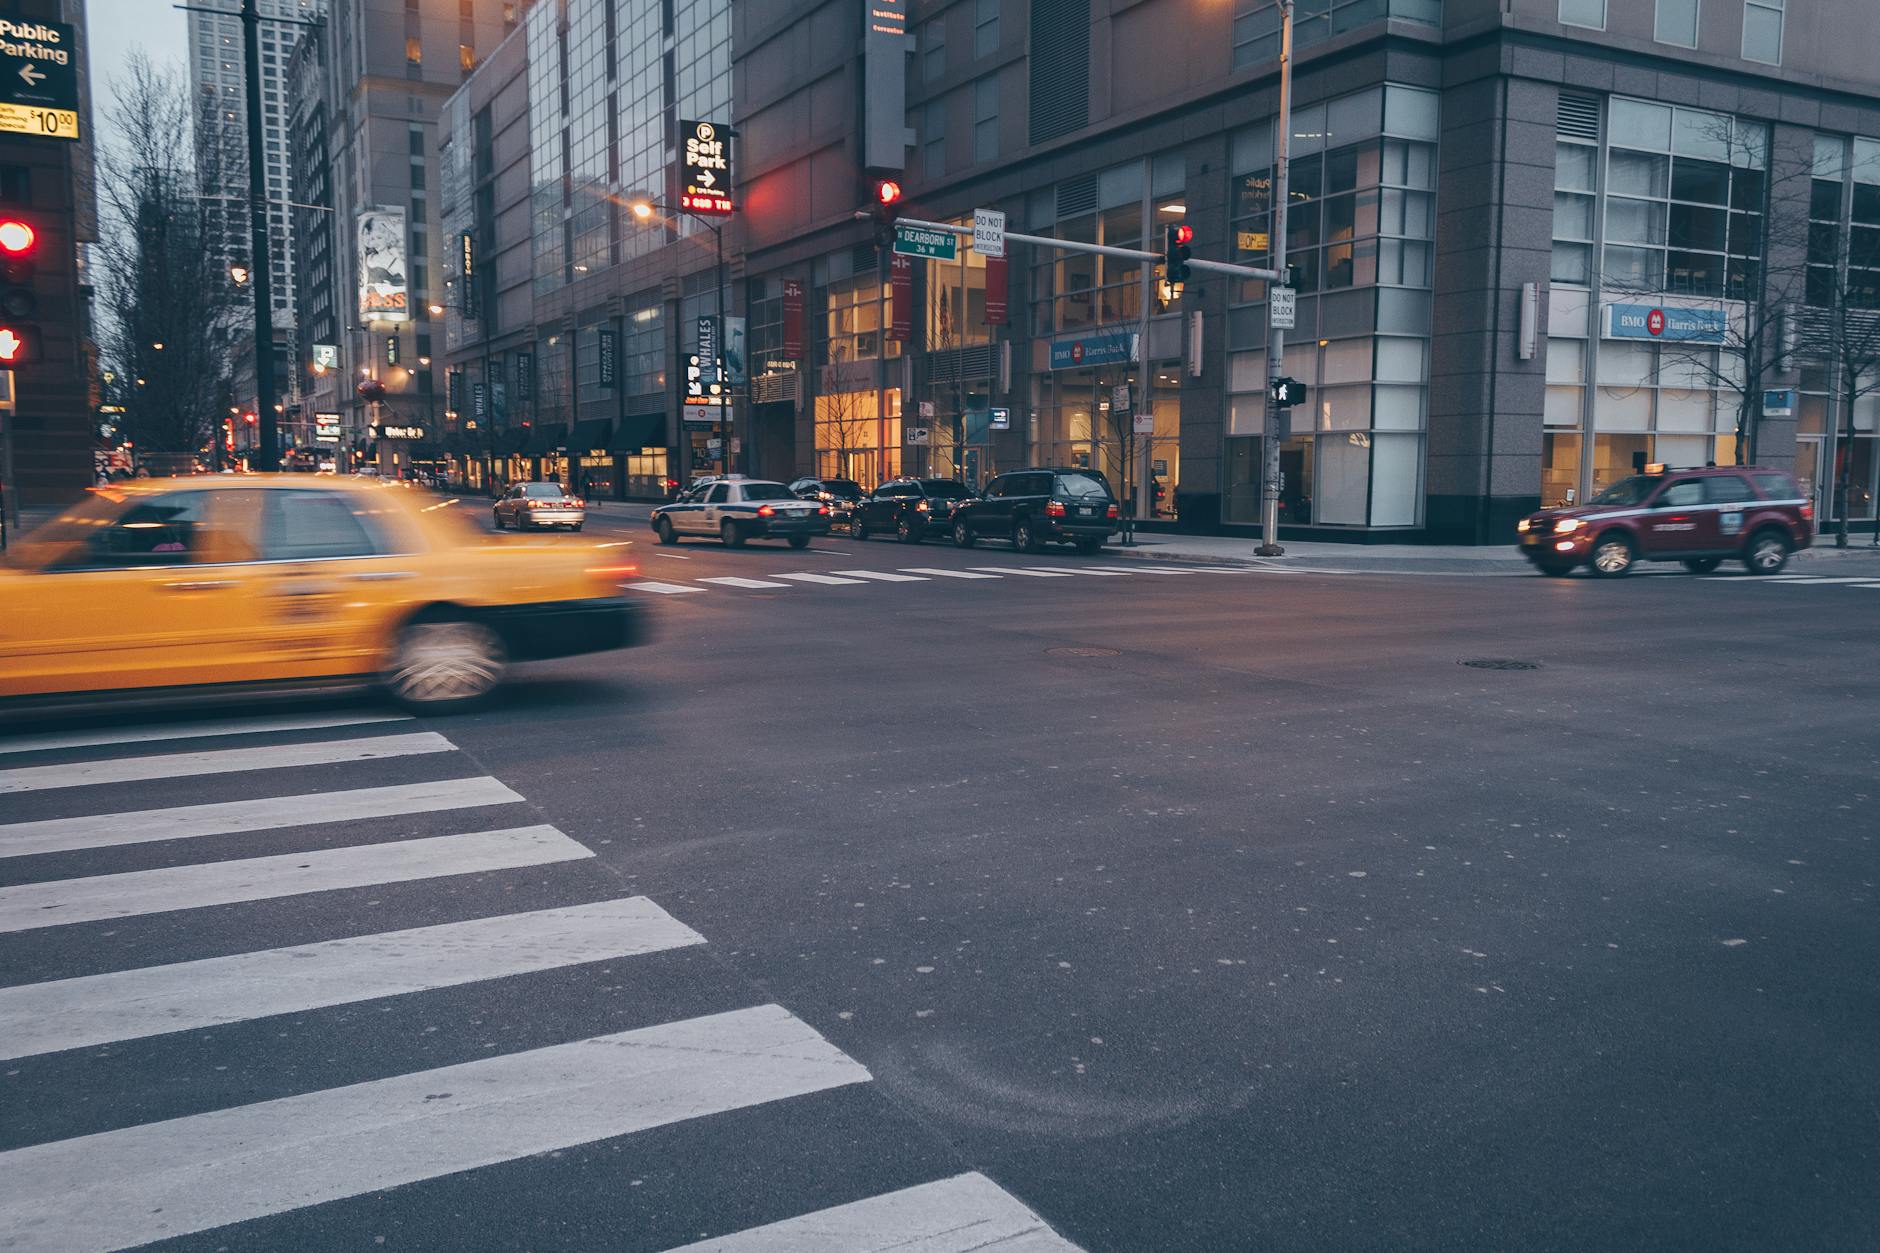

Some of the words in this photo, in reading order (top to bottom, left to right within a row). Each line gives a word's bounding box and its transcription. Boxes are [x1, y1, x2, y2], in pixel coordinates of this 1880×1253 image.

[0, 19, 60, 43] Public
[687, 138, 723, 155] Self
[686, 151, 727, 169] Park
[976, 216, 986, 226] DO
[988, 217, 1003, 228] NOT
[897, 231, 902, 239] N
[904, 230, 945, 246] DEARBORN
[947, 238, 954, 246] ST
[976, 230, 1001, 241] BLOCK
[916, 244, 926, 253] 36
[929, 246, 936, 254] W
[1273, 293, 1281, 302] DO
[1282, 294, 1295, 303] NOT
[1273, 306, 1294, 315] BLOCK
[1621, 315, 1645, 327] BMO
[1667, 318, 1696, 331] Harris
[1697, 320, 1719, 332] Bank
[700, 319, 712, 367] WHALES
[1055, 350, 1070, 360] BMO
[1085, 345, 1106, 357] Harris
[475, 384, 484, 415] WHALES
